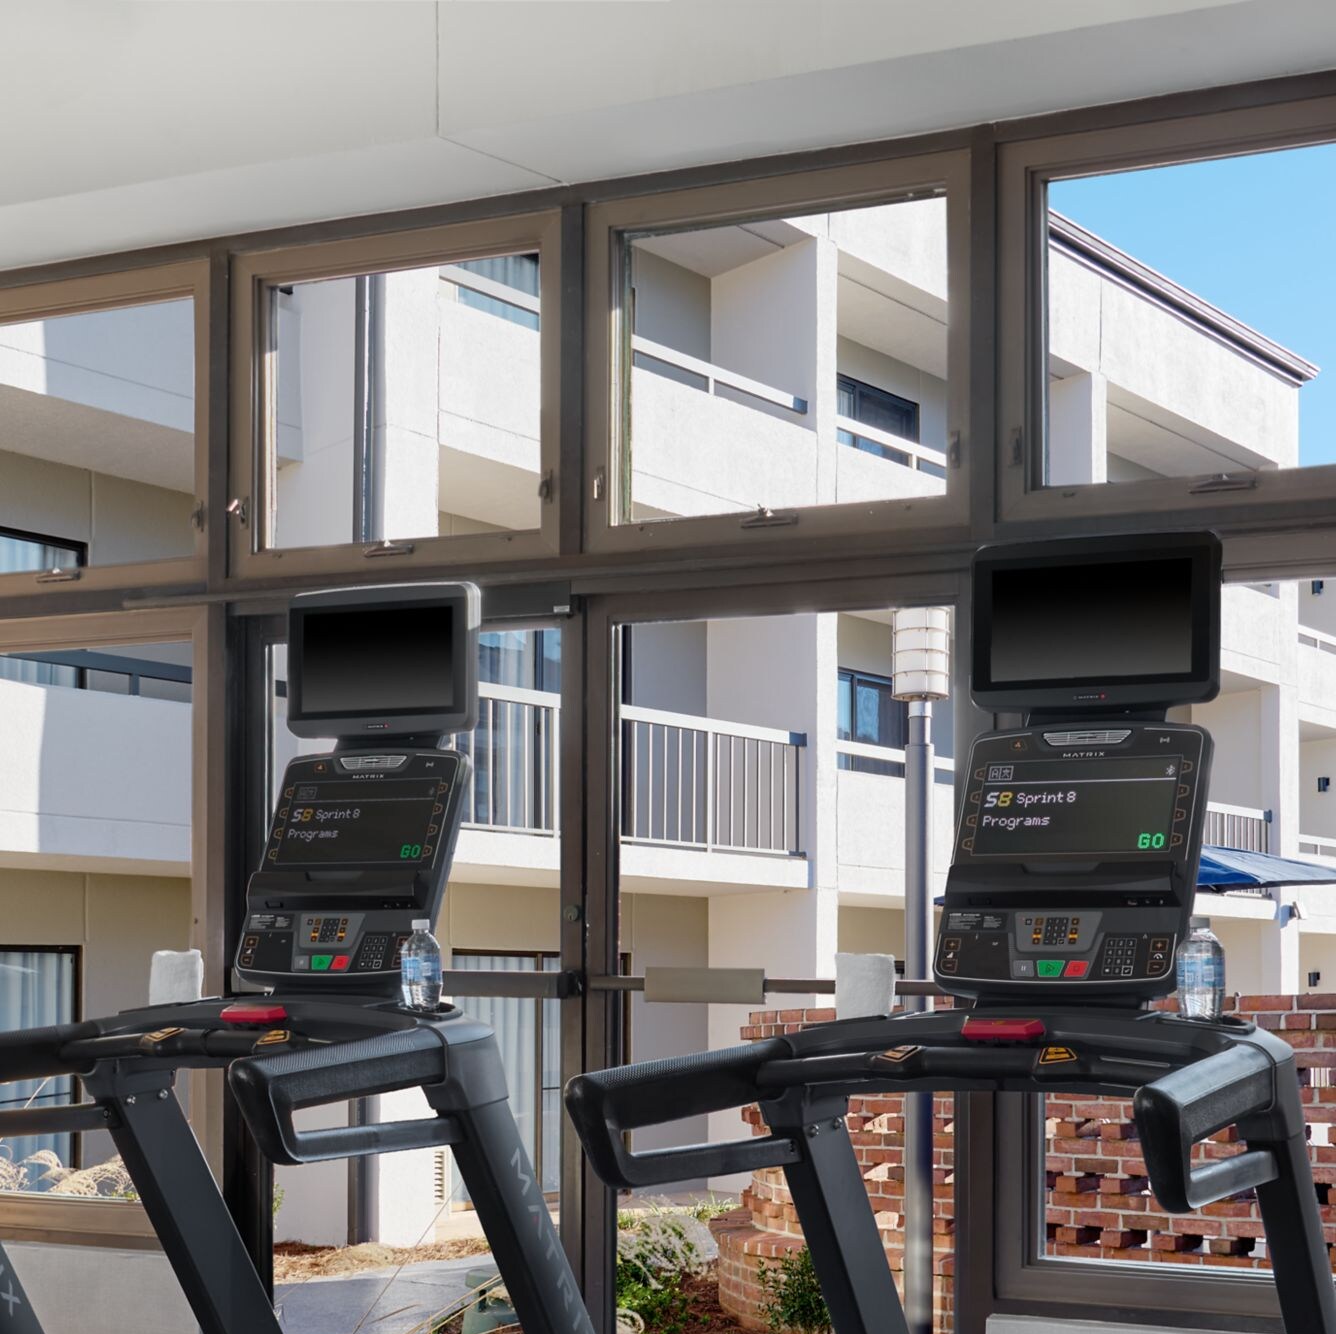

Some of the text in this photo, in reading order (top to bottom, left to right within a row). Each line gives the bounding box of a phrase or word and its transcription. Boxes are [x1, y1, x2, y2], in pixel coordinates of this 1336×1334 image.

[1016, 791, 1064, 808] Sprint
[1067, 791, 1077, 803] 8
[315, 808, 352, 823] Sprint
[352, 808, 361, 819] 8
[982, 815, 1050, 831] Programs
[287, 828, 339, 842] Programs
[1137, 832, 1165, 849] GO
[400, 844, 421, 858] GO
